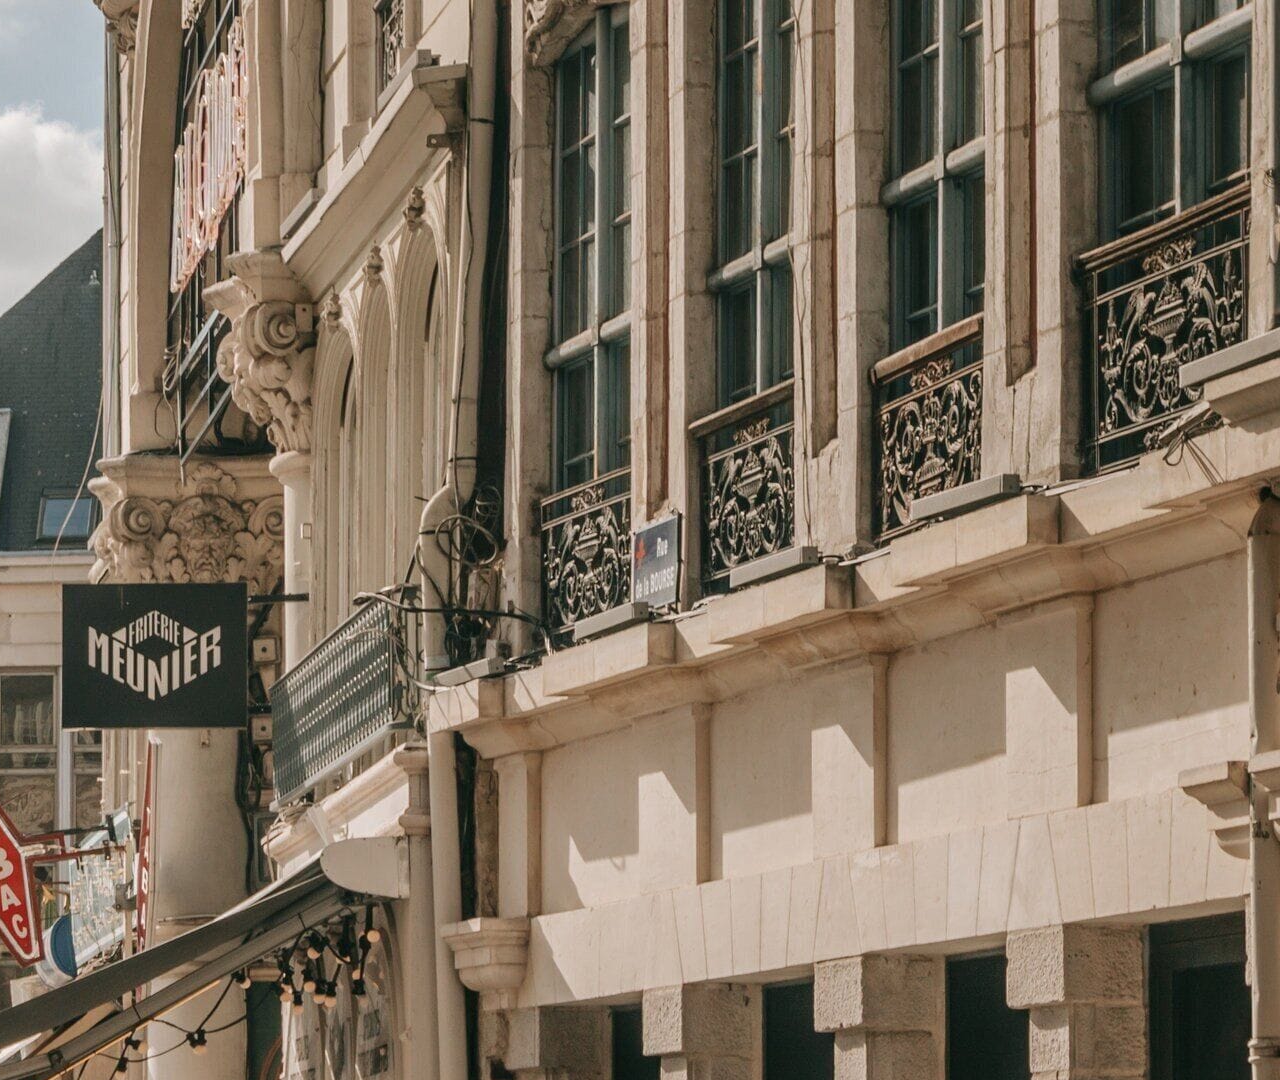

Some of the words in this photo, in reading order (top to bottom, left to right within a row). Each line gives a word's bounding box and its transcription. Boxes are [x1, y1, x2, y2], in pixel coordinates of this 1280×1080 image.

[656, 537, 668, 557] Rue
[635, 579, 643, 599] de
[643, 577, 649, 596] la
[650, 566, 674, 594] BOURSE
[128, 609, 181, 648] FRITERIE
[88, 624, 221, 701] MEUNIER
